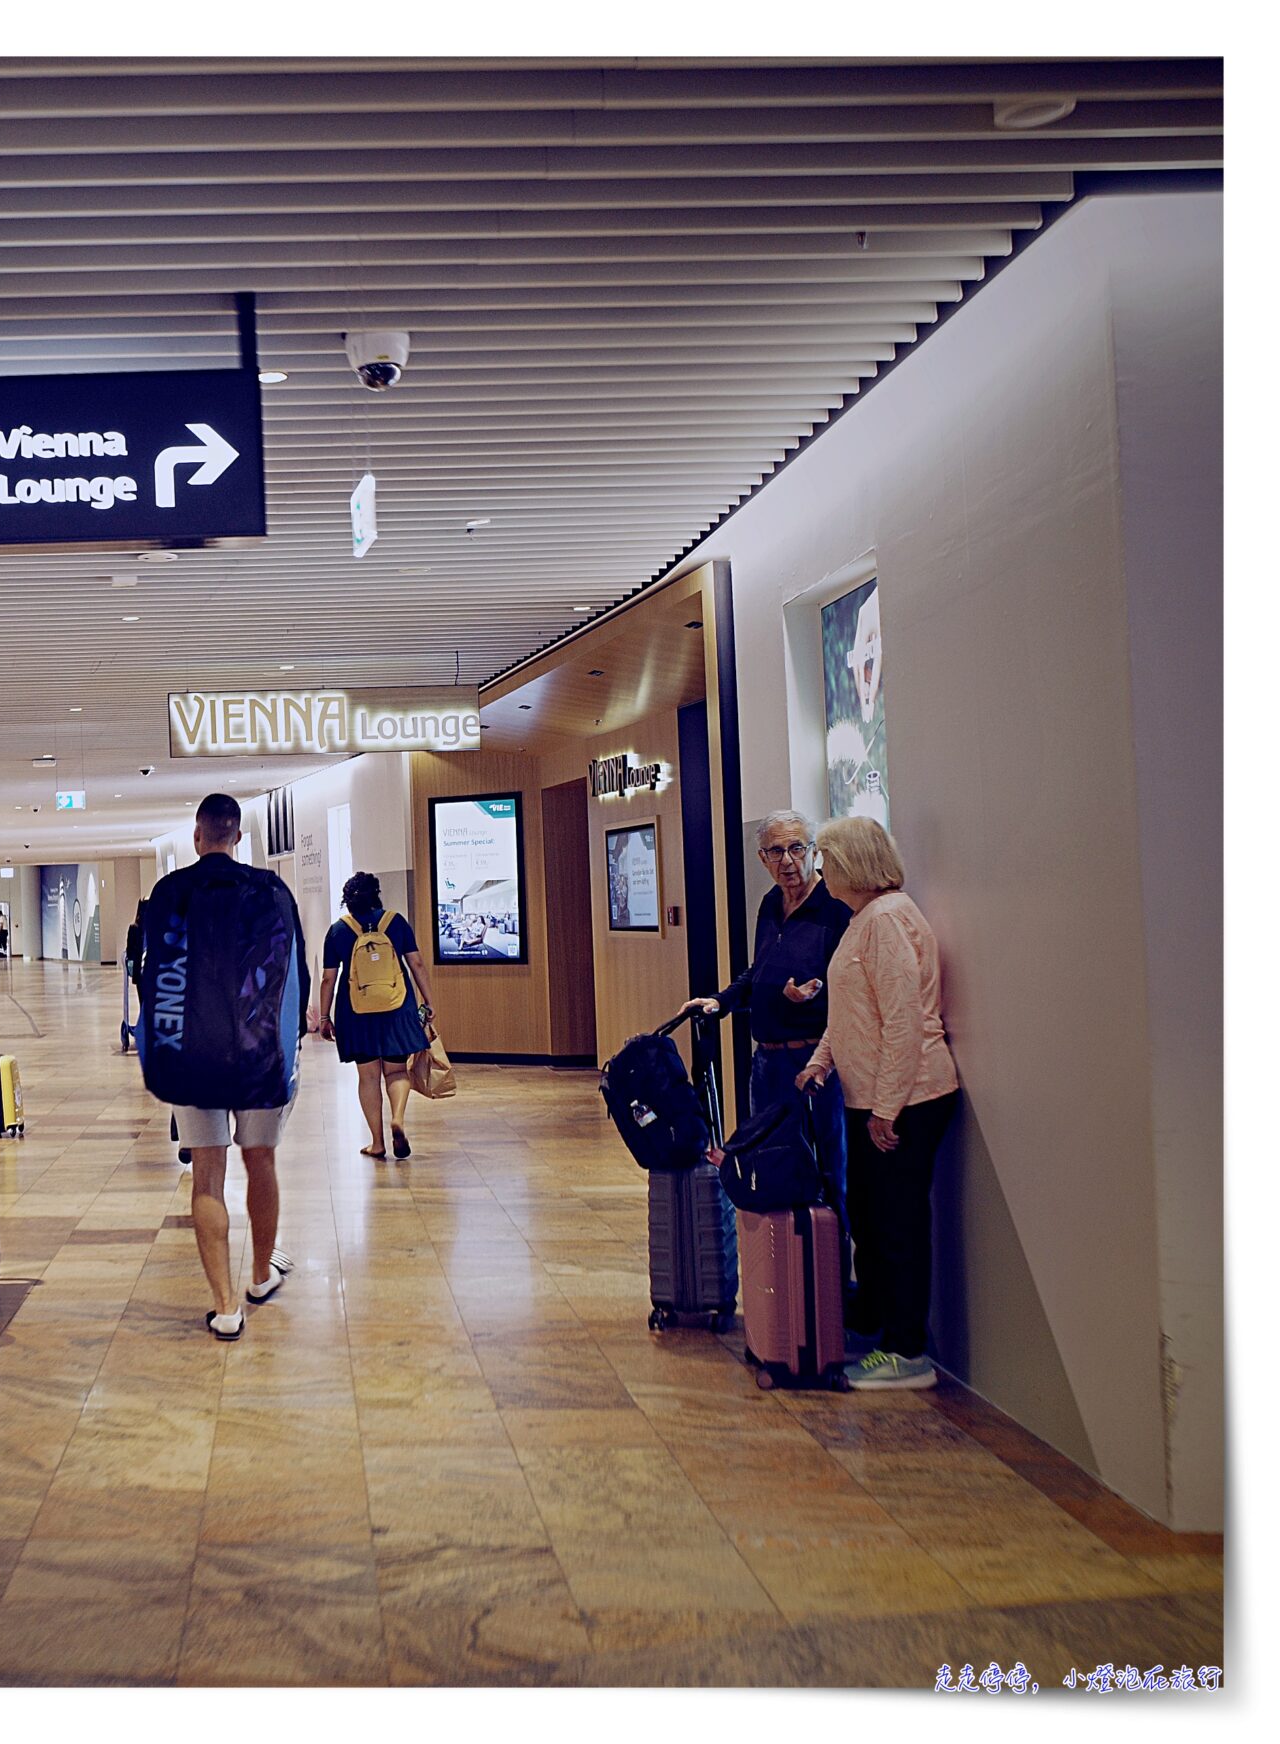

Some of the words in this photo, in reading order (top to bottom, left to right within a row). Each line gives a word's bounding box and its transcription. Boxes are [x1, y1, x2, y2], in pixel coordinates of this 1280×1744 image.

[173, 693, 347, 749] VIENNA
[360, 711, 480, 746] Lounge
[588, 754, 628, 797] VIENNA
[626, 763, 661, 791] Lounge
[442, 840, 470, 848] Summer
[153, 954, 188, 1051] YONEX
